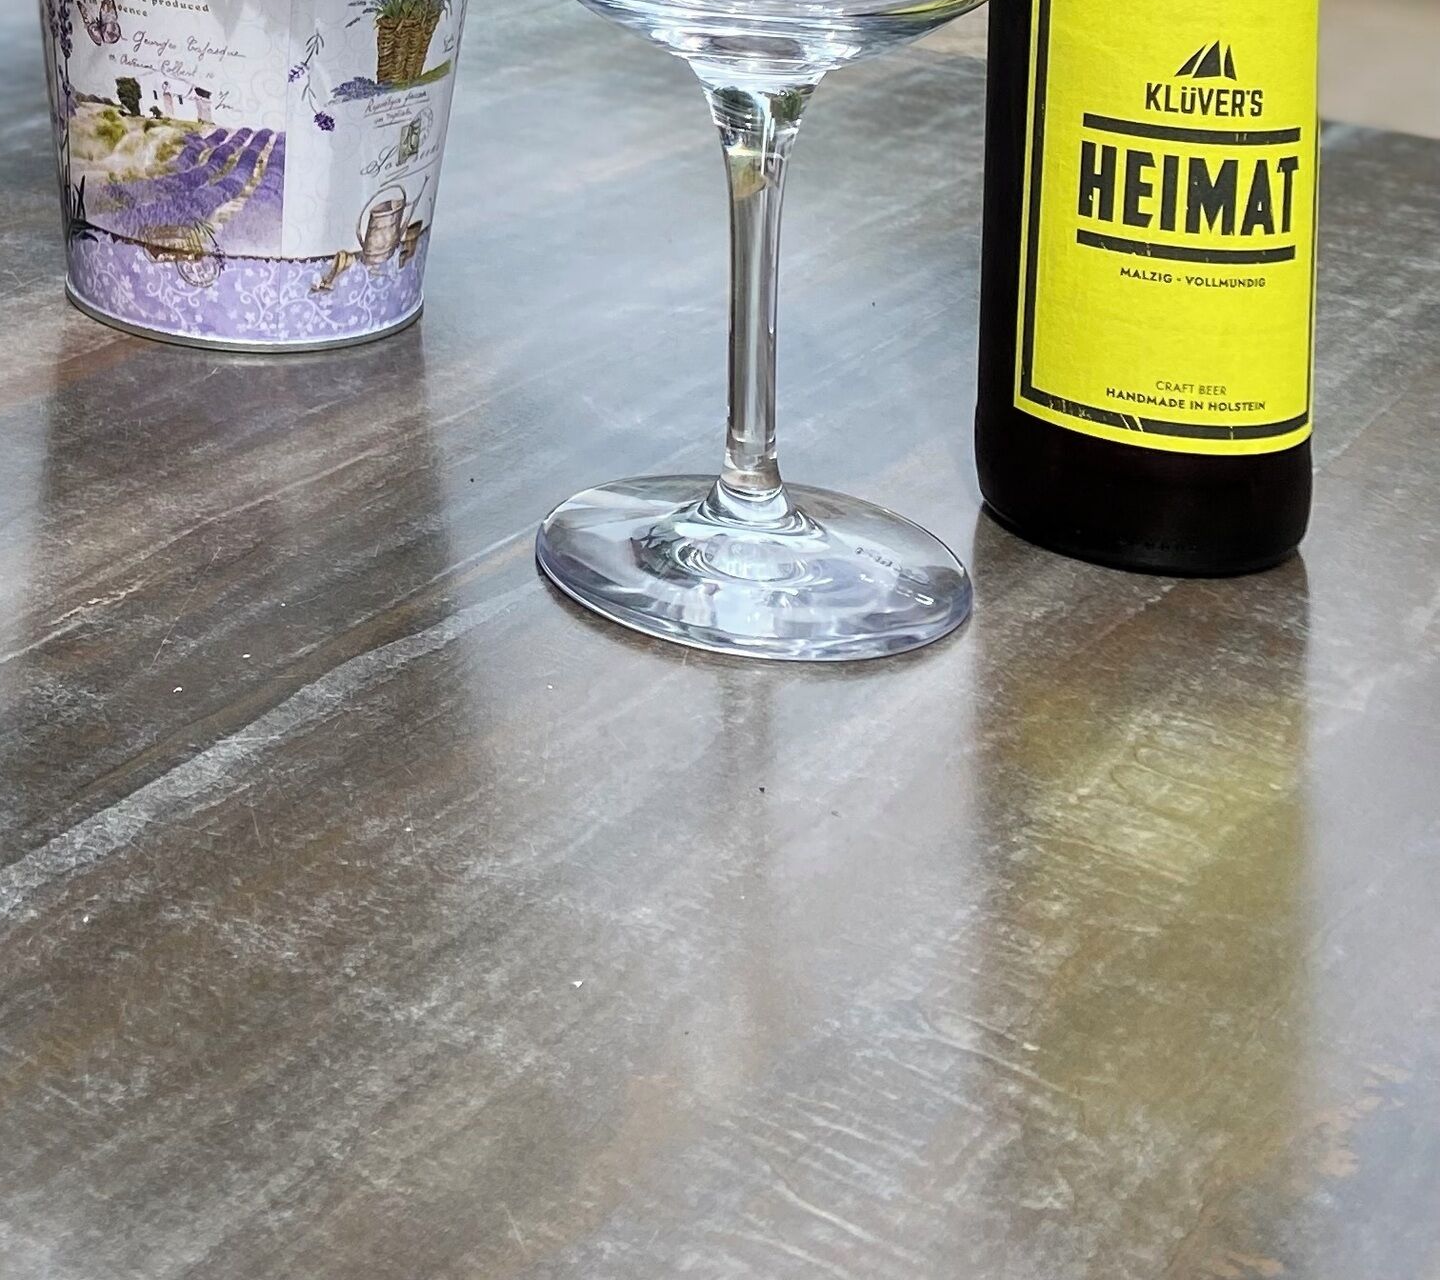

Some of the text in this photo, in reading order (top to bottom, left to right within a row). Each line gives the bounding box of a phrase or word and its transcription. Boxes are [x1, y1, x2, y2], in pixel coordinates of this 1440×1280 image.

[1077, 139, 1300, 236] HEIMAT
[1120, 267, 1173, 284] MALZIG
[1185, 276, 1266, 288] VOLLMUNDIG
[1106, 387, 1266, 412] HANDMADE IN HOLSTEIN
[1155, 380, 1227, 396] CRAFT BEER
